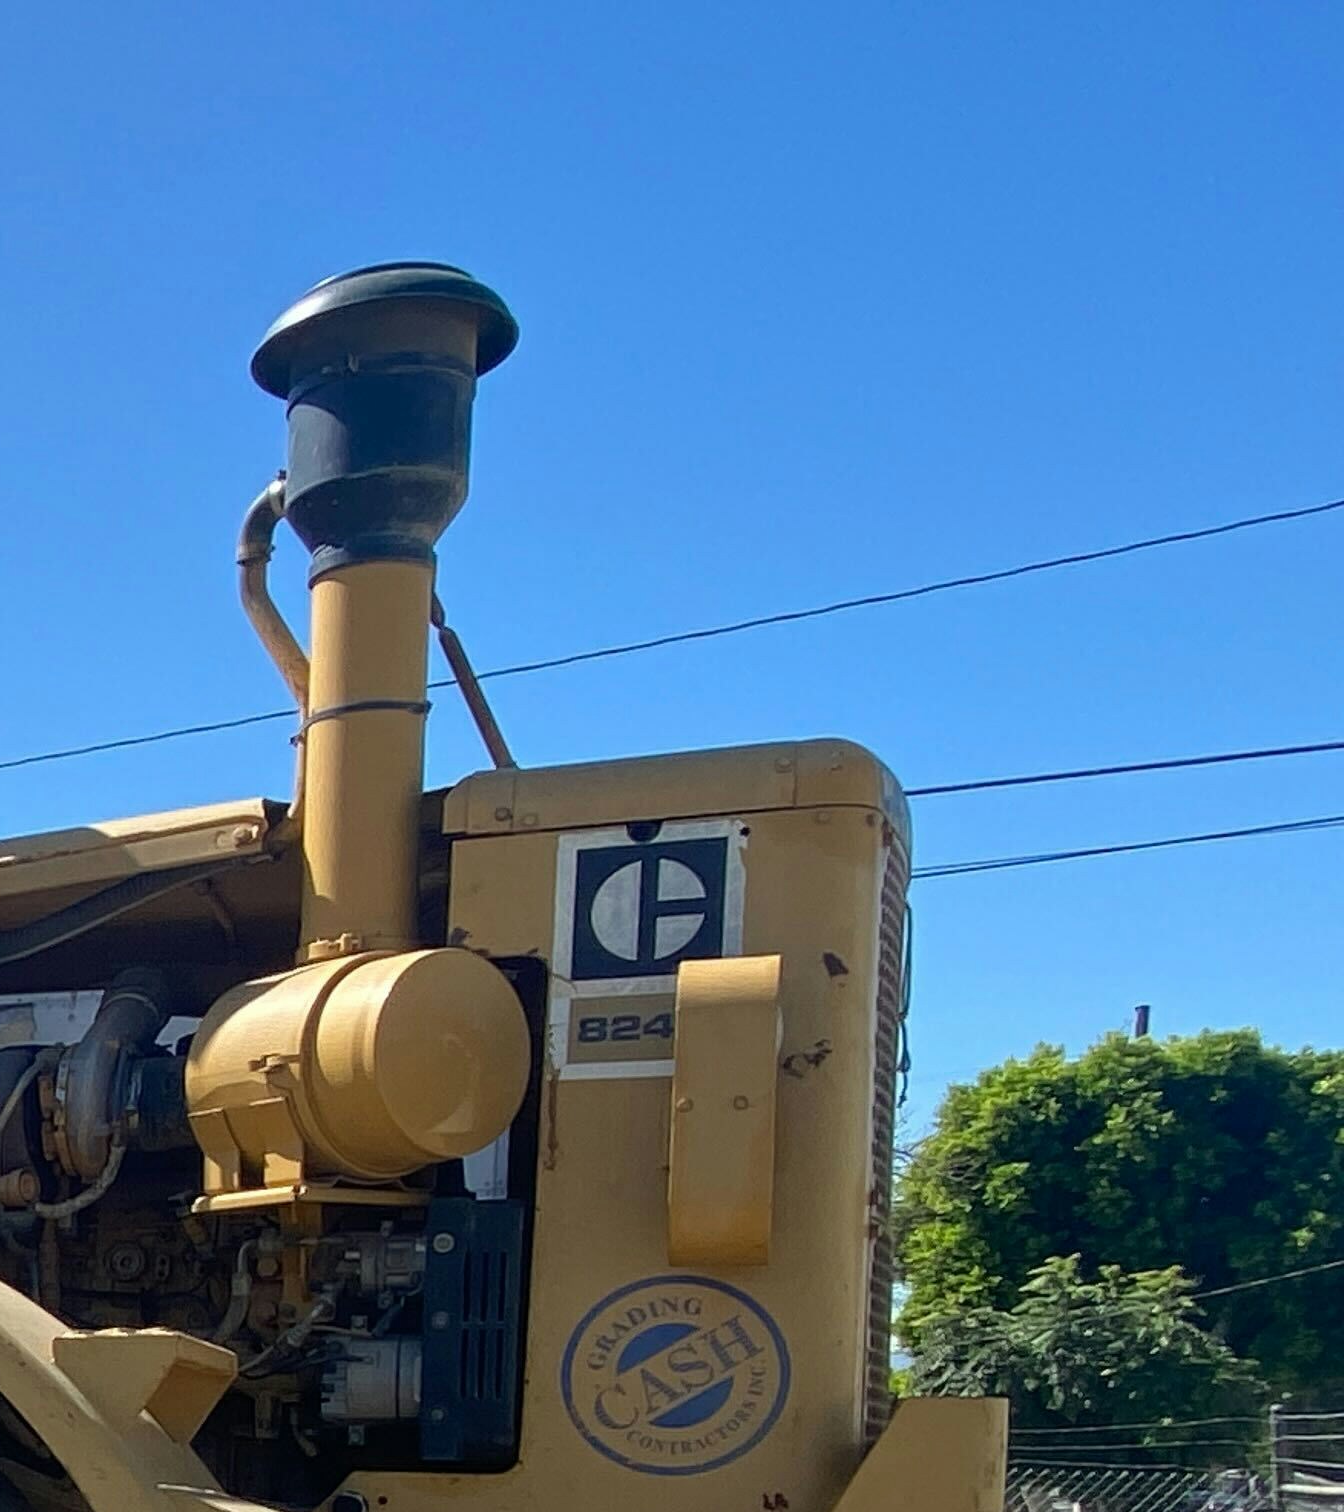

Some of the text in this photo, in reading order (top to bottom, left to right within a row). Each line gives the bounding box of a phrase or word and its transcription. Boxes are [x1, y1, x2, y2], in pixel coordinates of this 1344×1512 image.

[578, 1013, 674, 1043] 824
[587, 1296, 702, 1371] GRADING
[594, 1315, 764, 1430] CASH
[626, 1401, 757, 1456] CONTRACTORS
